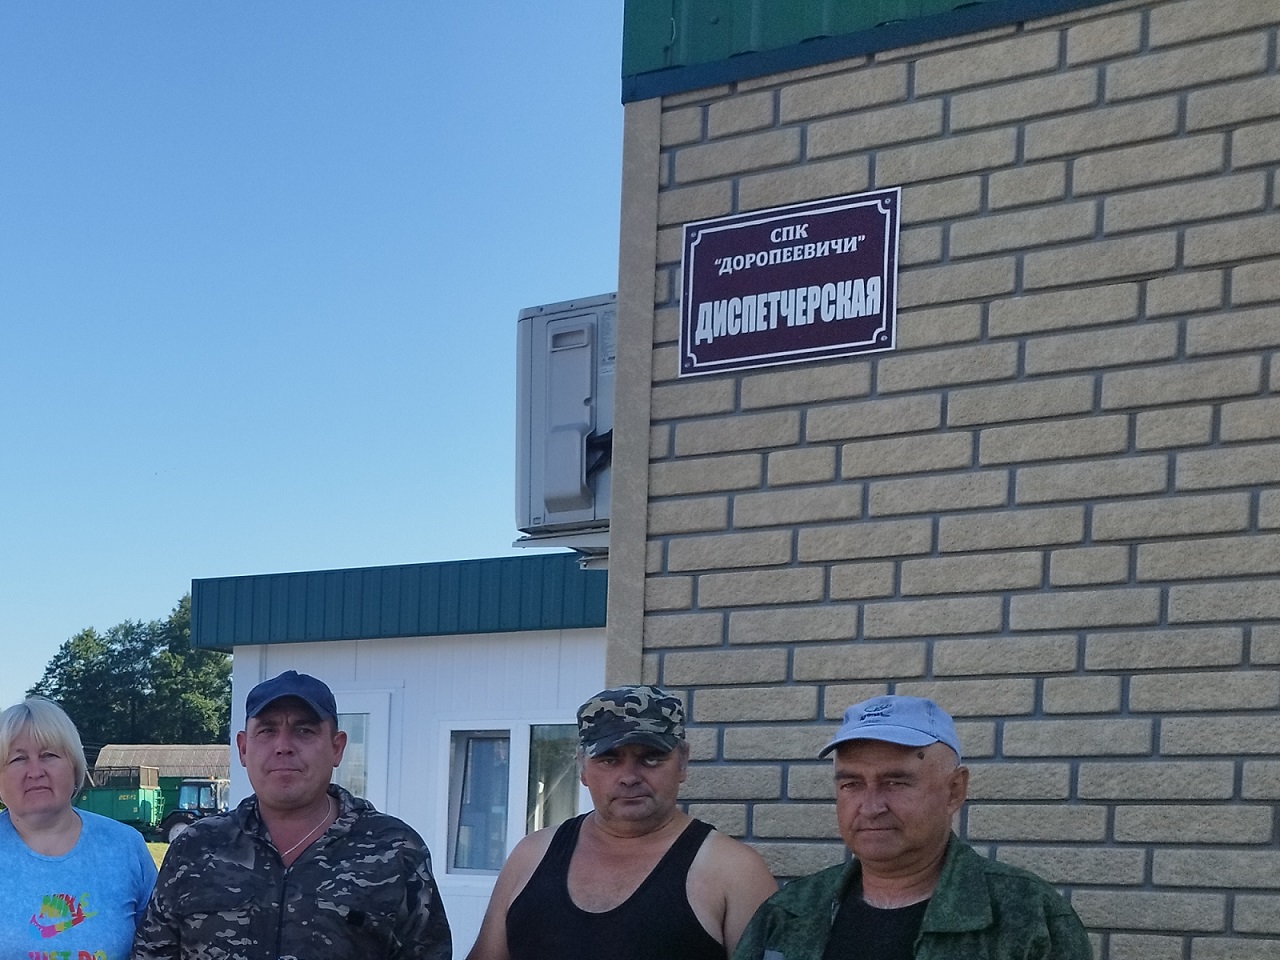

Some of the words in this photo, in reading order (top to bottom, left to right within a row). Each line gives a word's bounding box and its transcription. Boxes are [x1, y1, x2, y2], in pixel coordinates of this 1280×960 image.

[770, 223, 809, 243] СПК
[714, 234, 866, 276] “ДОРОПЕЕВИЧИ”
[695, 275, 882, 346] ДИСПЕТЧЕРСКАЯ
